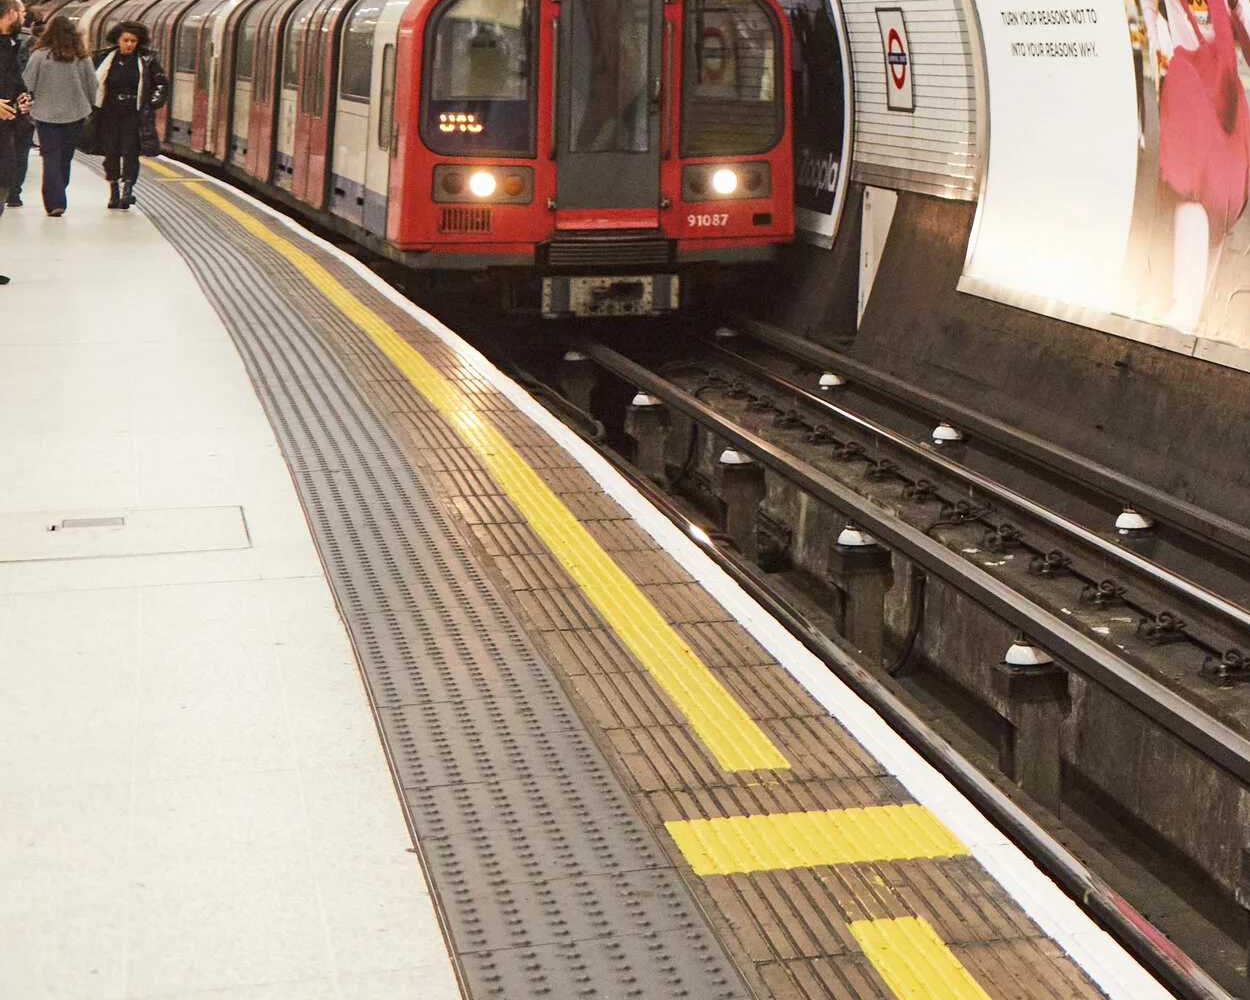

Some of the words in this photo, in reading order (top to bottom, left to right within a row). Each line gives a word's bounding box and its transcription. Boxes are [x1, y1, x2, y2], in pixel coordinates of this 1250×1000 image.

[1001, 11, 1019, 25] TURN
[1019, 11, 1037, 25] YOUR
[1038, 9, 1070, 25] REASONS
[1070, 8, 1085, 24] NOT
[1086, 8, 1098, 24] TO
[1011, 42, 1026, 56] INTO
[1027, 42, 1044, 57] YOUR
[1045, 42, 1078, 57] REASONS
[687, 213, 729, 227] 91087
